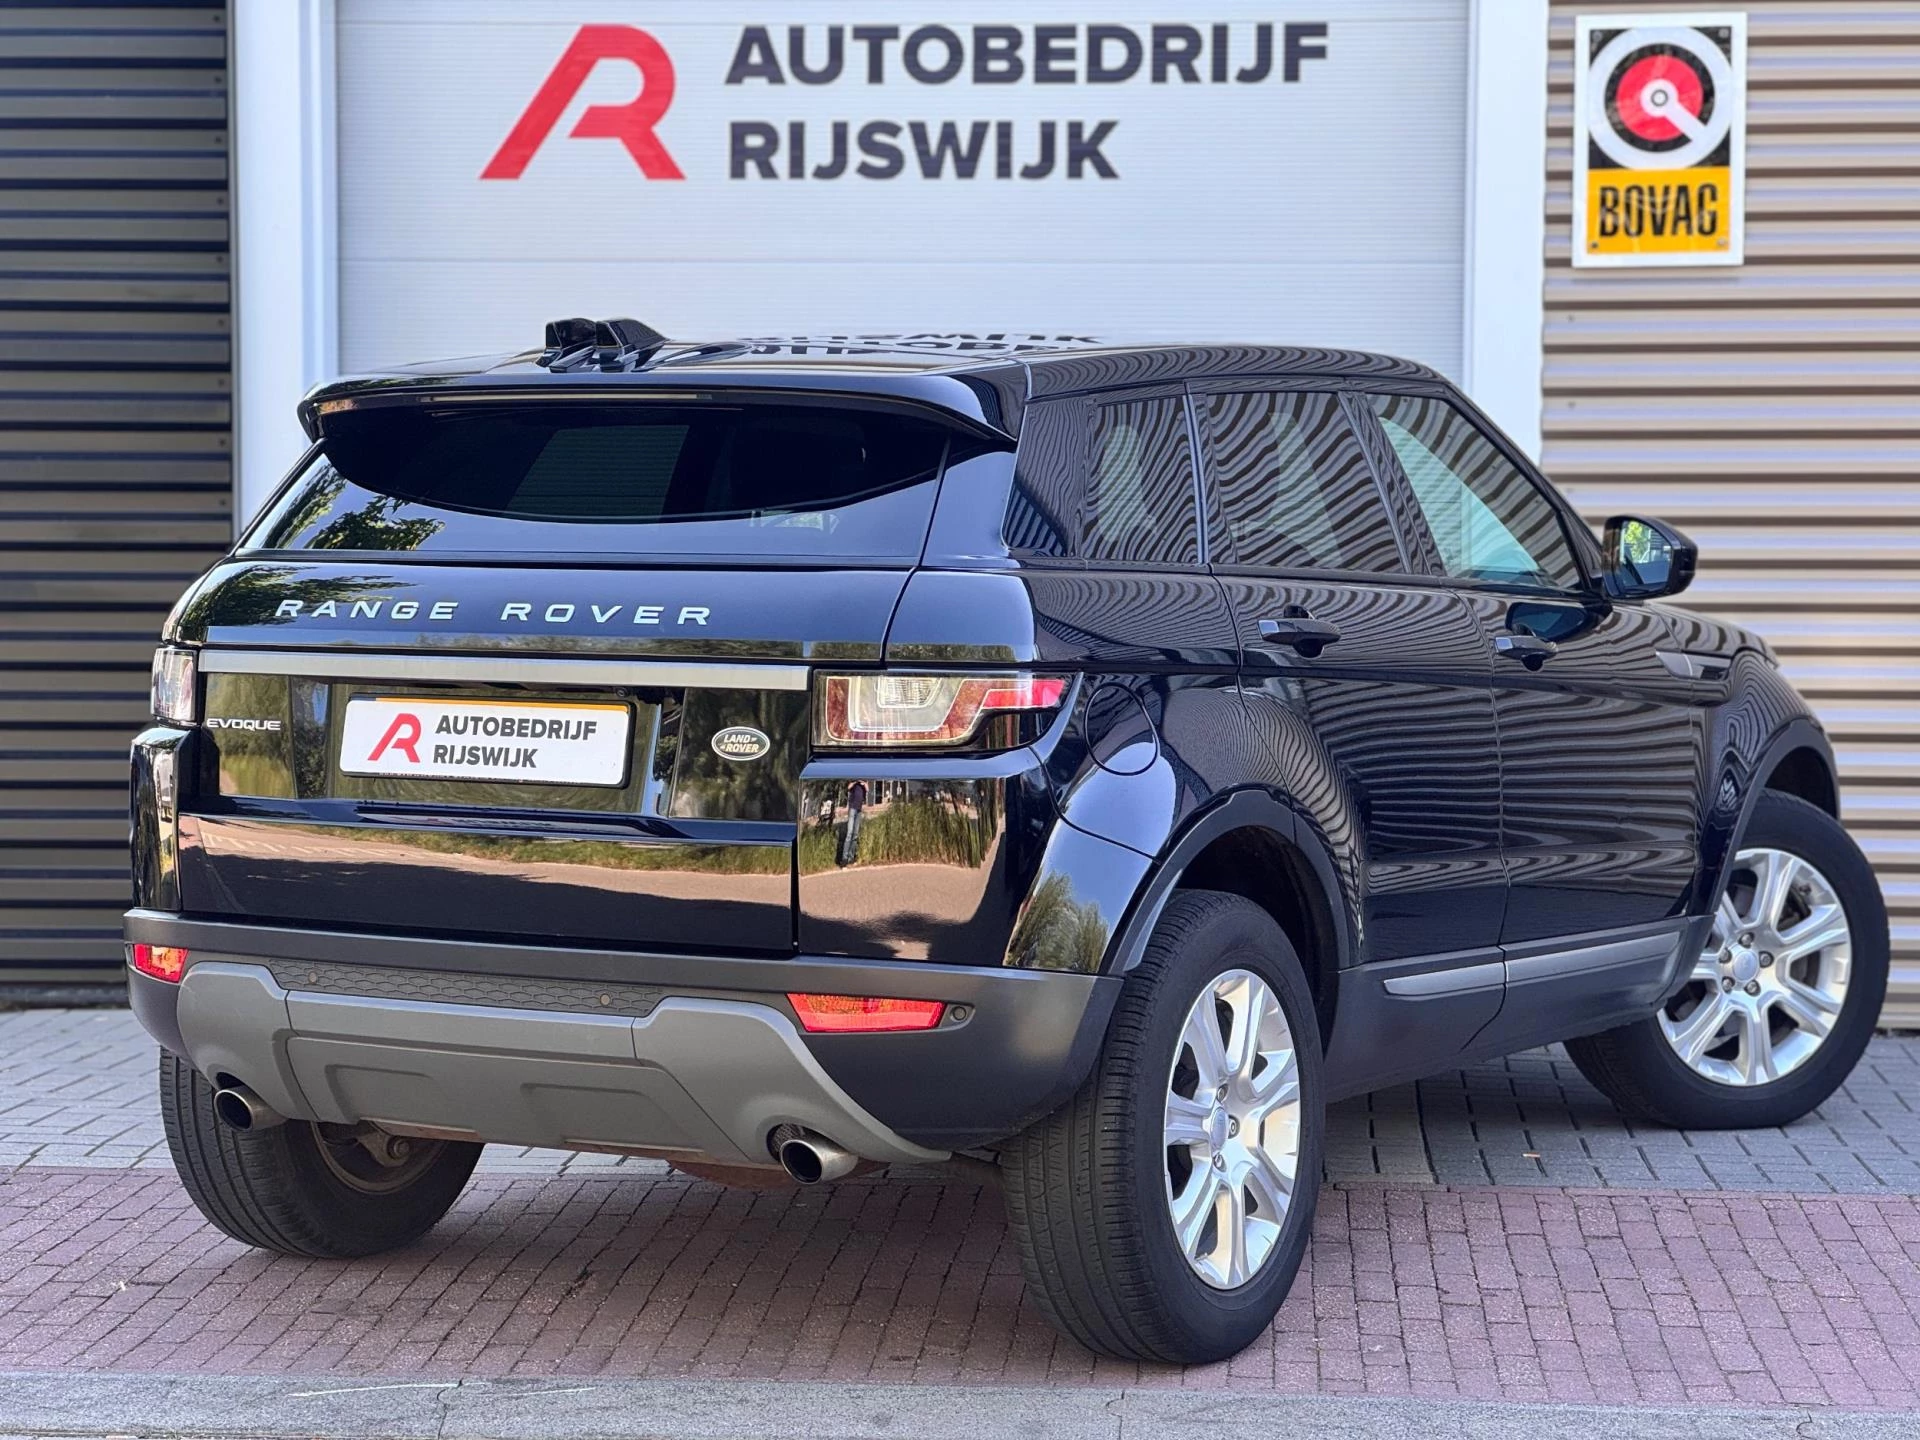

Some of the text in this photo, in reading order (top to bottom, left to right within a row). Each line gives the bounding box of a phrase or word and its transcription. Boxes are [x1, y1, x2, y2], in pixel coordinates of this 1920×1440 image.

[725, 22, 1328, 85] AUTOBEDRIJF
[729, 120, 1119, 180] RIJSWIJK
[1600, 184, 1718, 238] BOVAG
[275, 599, 710, 626] RANGE ROVER
[206, 718, 282, 732] EVOQUE
[435, 714, 598, 741] AUTOBEDRIJF
[723, 734, 751, 744] LAND
[725, 743, 760, 753] ROVER
[433, 744, 538, 768] RIJSWIJK
